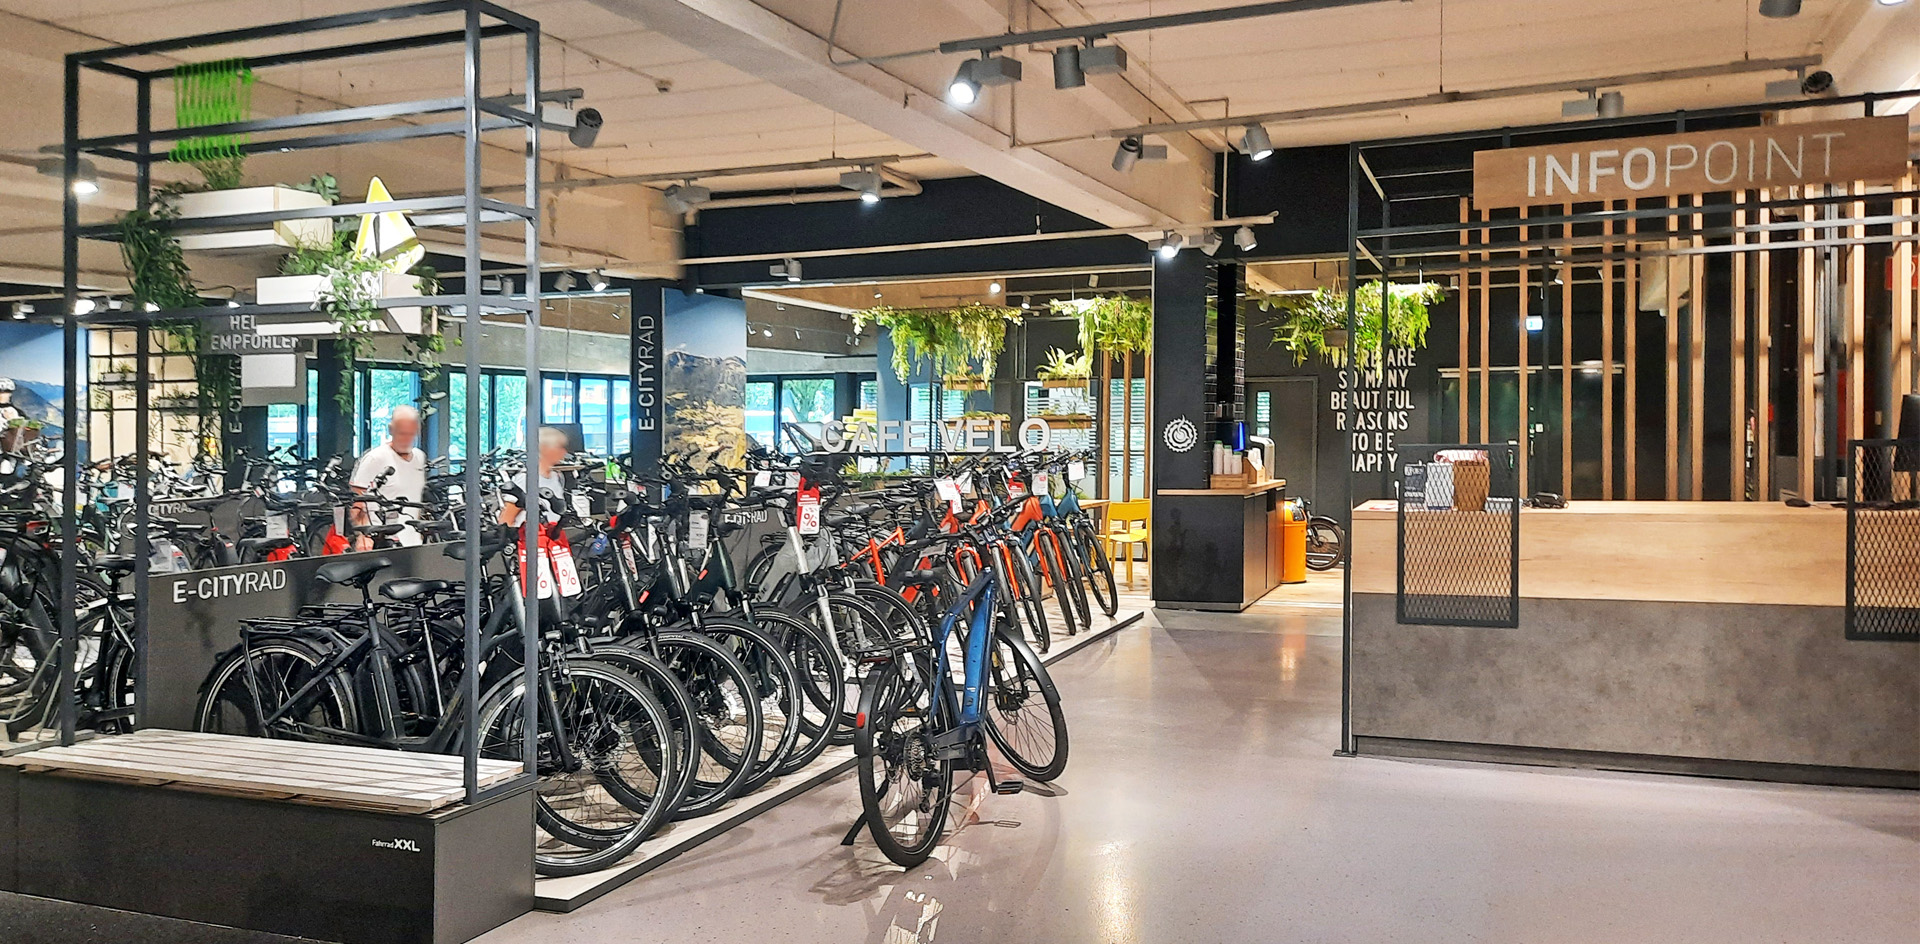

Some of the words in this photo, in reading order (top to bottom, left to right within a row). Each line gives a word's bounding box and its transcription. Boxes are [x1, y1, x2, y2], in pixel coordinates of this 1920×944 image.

[1528, 132, 1845, 198] INFOPOINT
[229, 314, 257, 330] HEL
[1387, 348, 1416, 367] ARE
[638, 315, 655, 431] E-CITYRAD
[1365, 368, 1409, 389] MNY
[1330, 390, 1415, 410] BEAUTFUL
[821, 420, 927, 453] CAFE
[937, 418, 1050, 452] VELO
[1375, 432, 1395, 451] BE
[172, 568, 287, 604] E-CITYRAD
